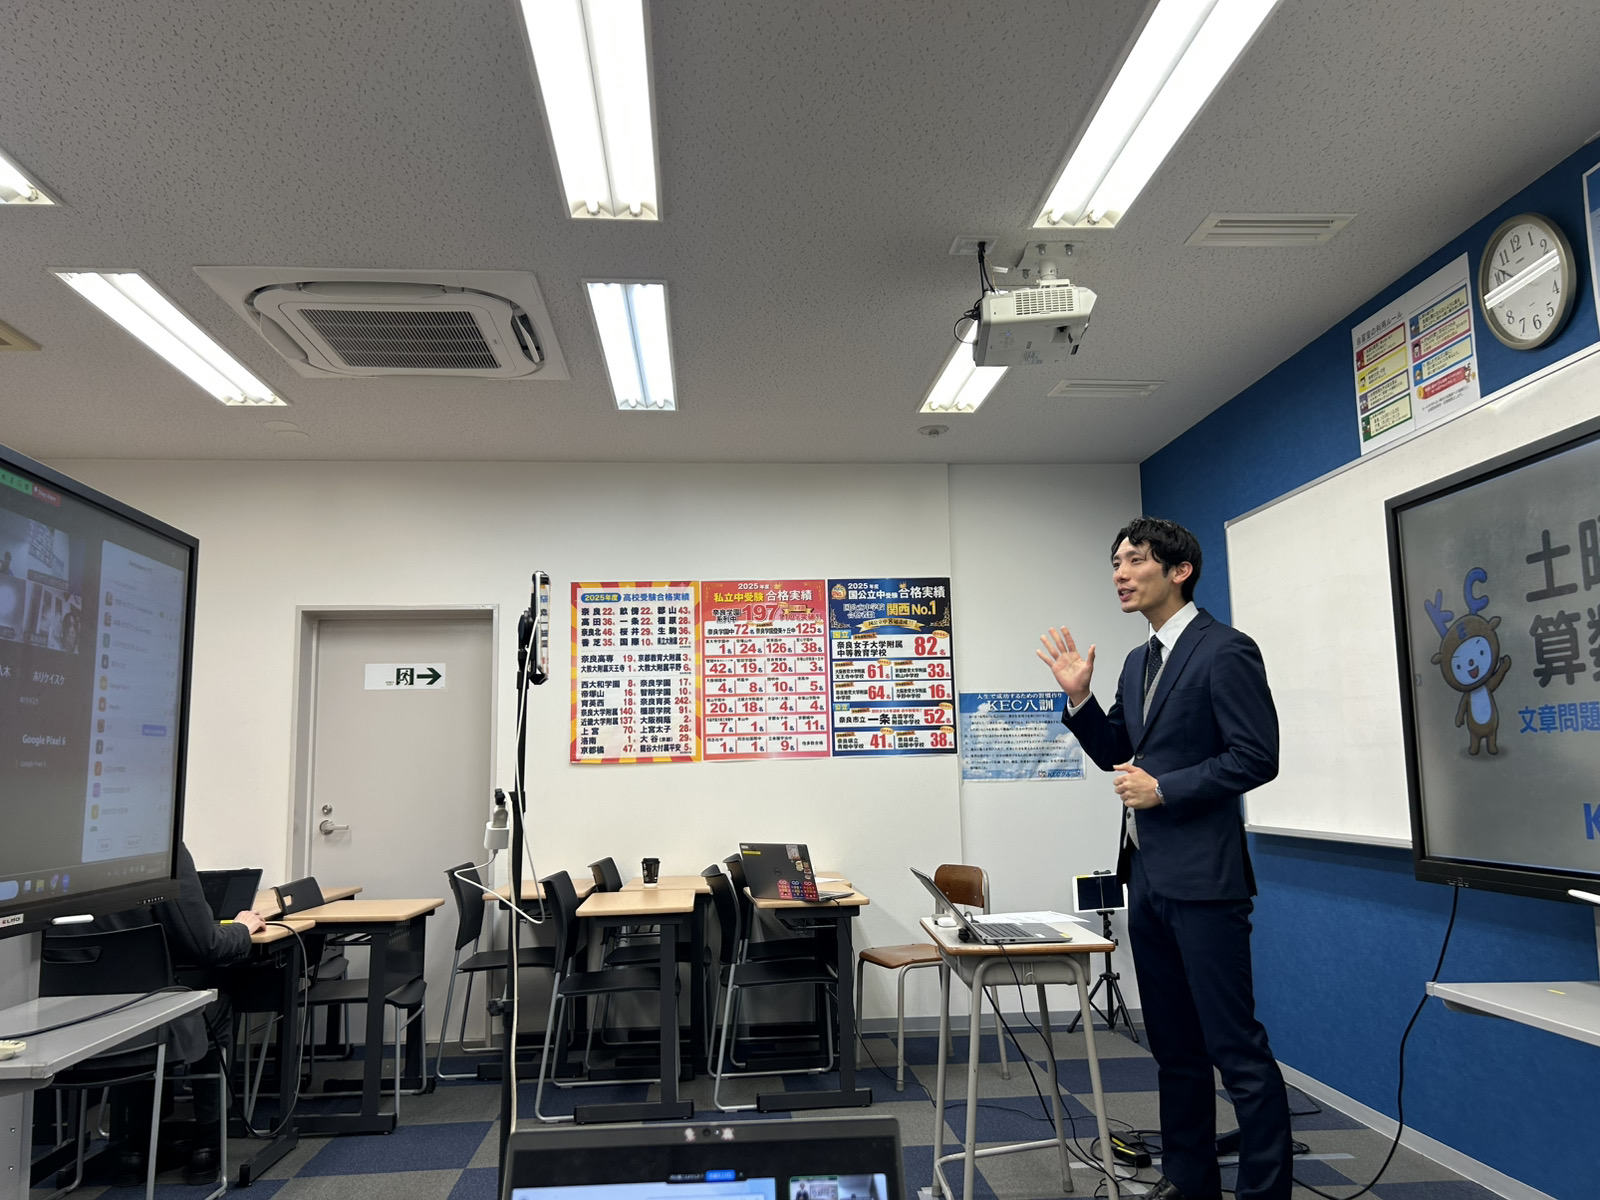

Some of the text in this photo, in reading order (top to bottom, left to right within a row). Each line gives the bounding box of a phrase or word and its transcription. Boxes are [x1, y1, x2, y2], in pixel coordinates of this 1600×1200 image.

[1510, 235, 1521, 252] 12
[1527, 232, 1534, 245] 1
[1540, 239, 1548, 254] 2
[1500, 250, 1510, 266] 11
[1552, 280, 1560, 294] 4
[1547, 303, 1554, 317] 5
[1506, 310, 1514, 324] 8
[1533, 315, 1542, 329] 6
[1520, 318, 1526, 333] 7
[623, 593, 689, 601] 高校受験合格実績
[714, 590, 812, 603] 私立中受験 合格実績
[898, 586, 945, 598] 合格実績
[742, 604, 778, 621] 197
[886, 601, 936, 616] 関西 No.1
[582, 618, 600, 626] 高田
[582, 628, 601, 636] 奈良北
[837, 636, 946, 656] 奈良女子大学附属 82名
[581, 655, 613, 663] 奈良高専
[837, 649, 887, 657] 中等教育学校
[581, 680, 620, 688] 西大和学園
[640, 679, 671, 687] 奈良学園
[988, 699, 1054, 712] KEC八訓
[581, 708, 618, 716] 奈良大学附属
[868, 714, 890, 725] 一条
[581, 727, 599, 735] 上宮
[640, 726, 671, 734] 上宮太子
[22, 734, 45, 746] Google
[2, 916, 21, 925] ELMO
